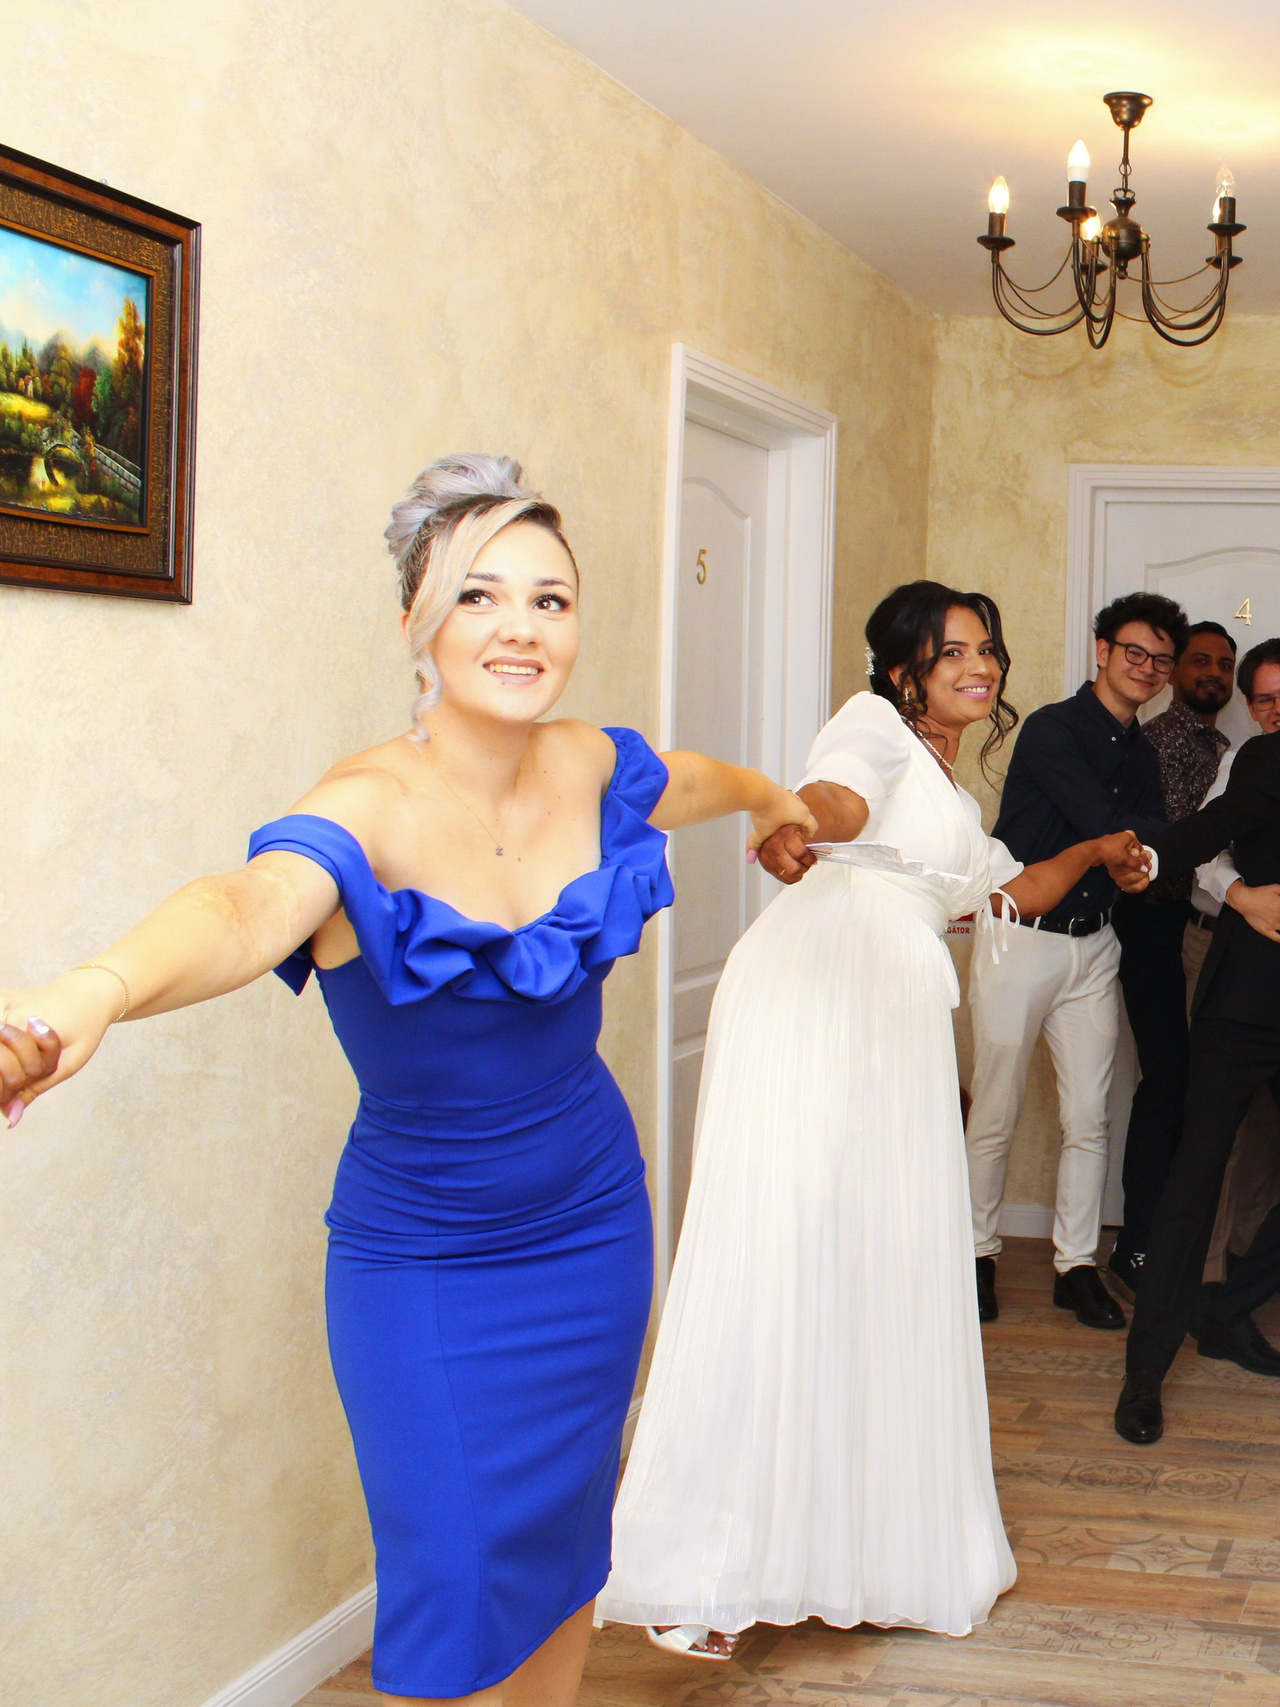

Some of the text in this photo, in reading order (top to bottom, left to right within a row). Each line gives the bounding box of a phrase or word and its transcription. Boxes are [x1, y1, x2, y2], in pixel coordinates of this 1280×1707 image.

[696, 548, 707, 585] 5
[1234, 598, 1252, 626] 4
[947, 925, 970, 934] GĂTOR
